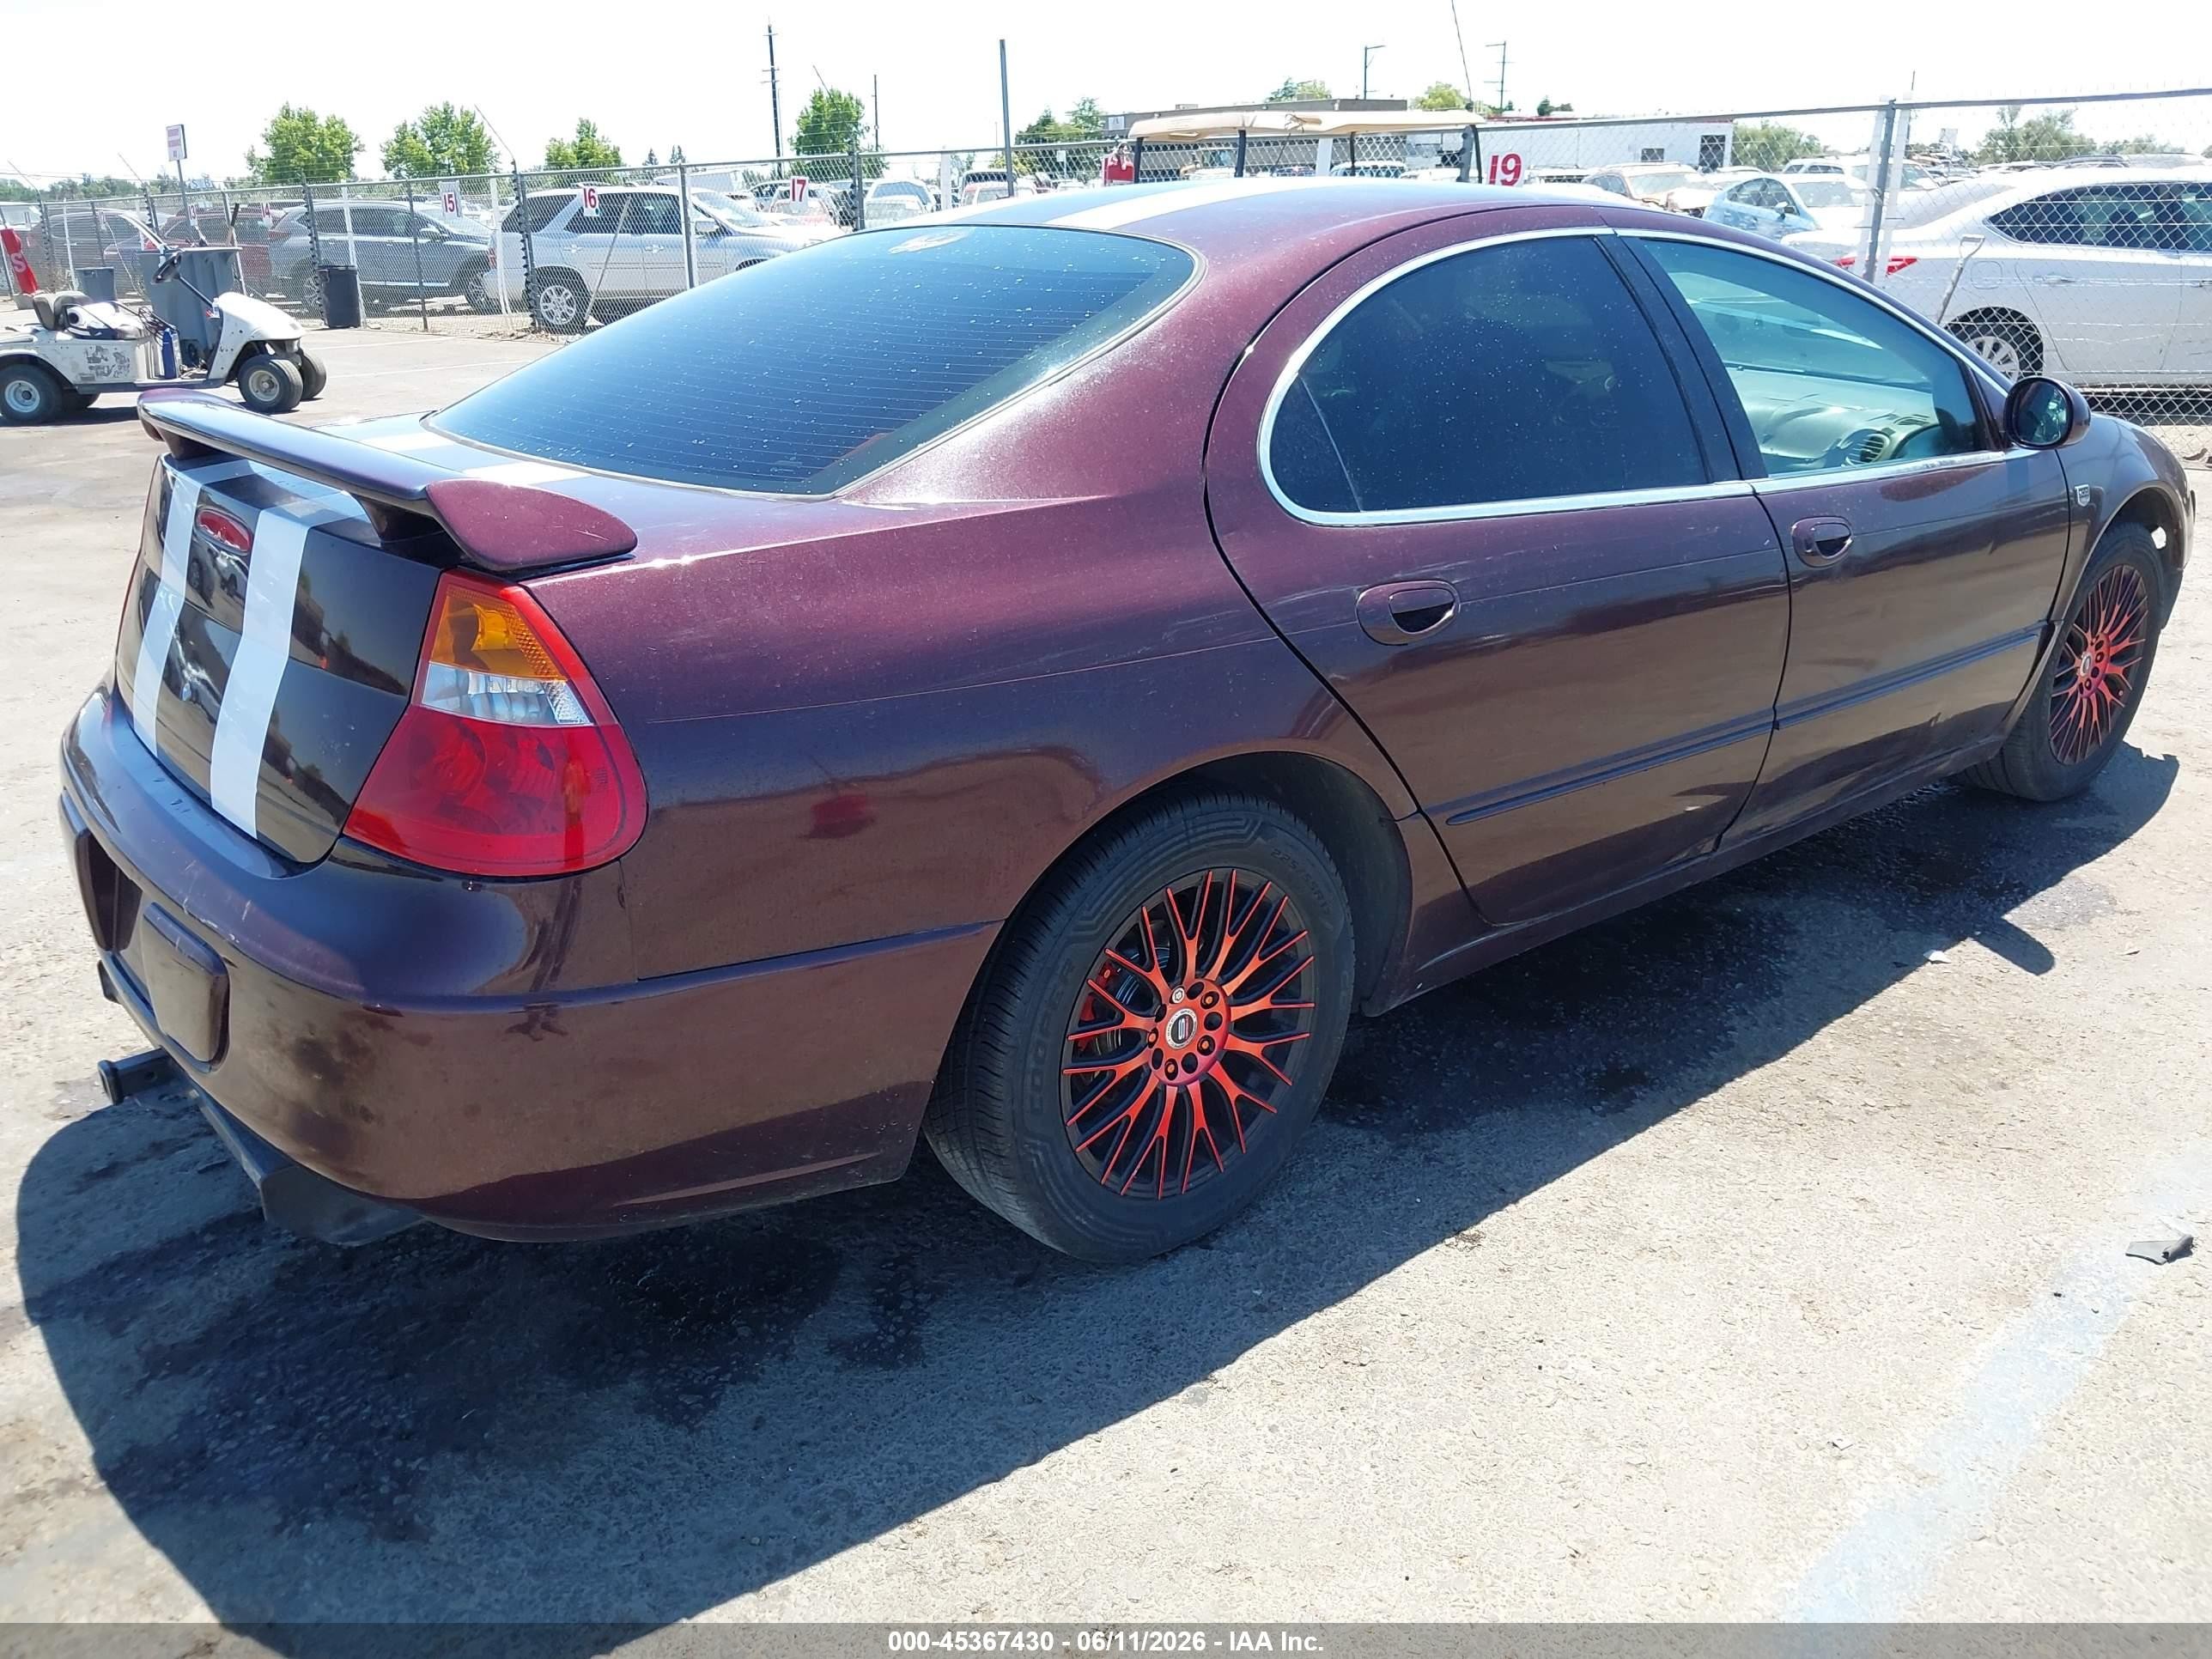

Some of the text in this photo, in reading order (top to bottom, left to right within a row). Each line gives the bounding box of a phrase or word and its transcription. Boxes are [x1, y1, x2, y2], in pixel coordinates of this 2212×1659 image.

[1488, 153, 1522, 186] 19
[583, 187, 597, 209] 16
[792, 178, 807, 202] 17
[443, 193, 456, 213] 15
[10, 252, 27, 273] S
